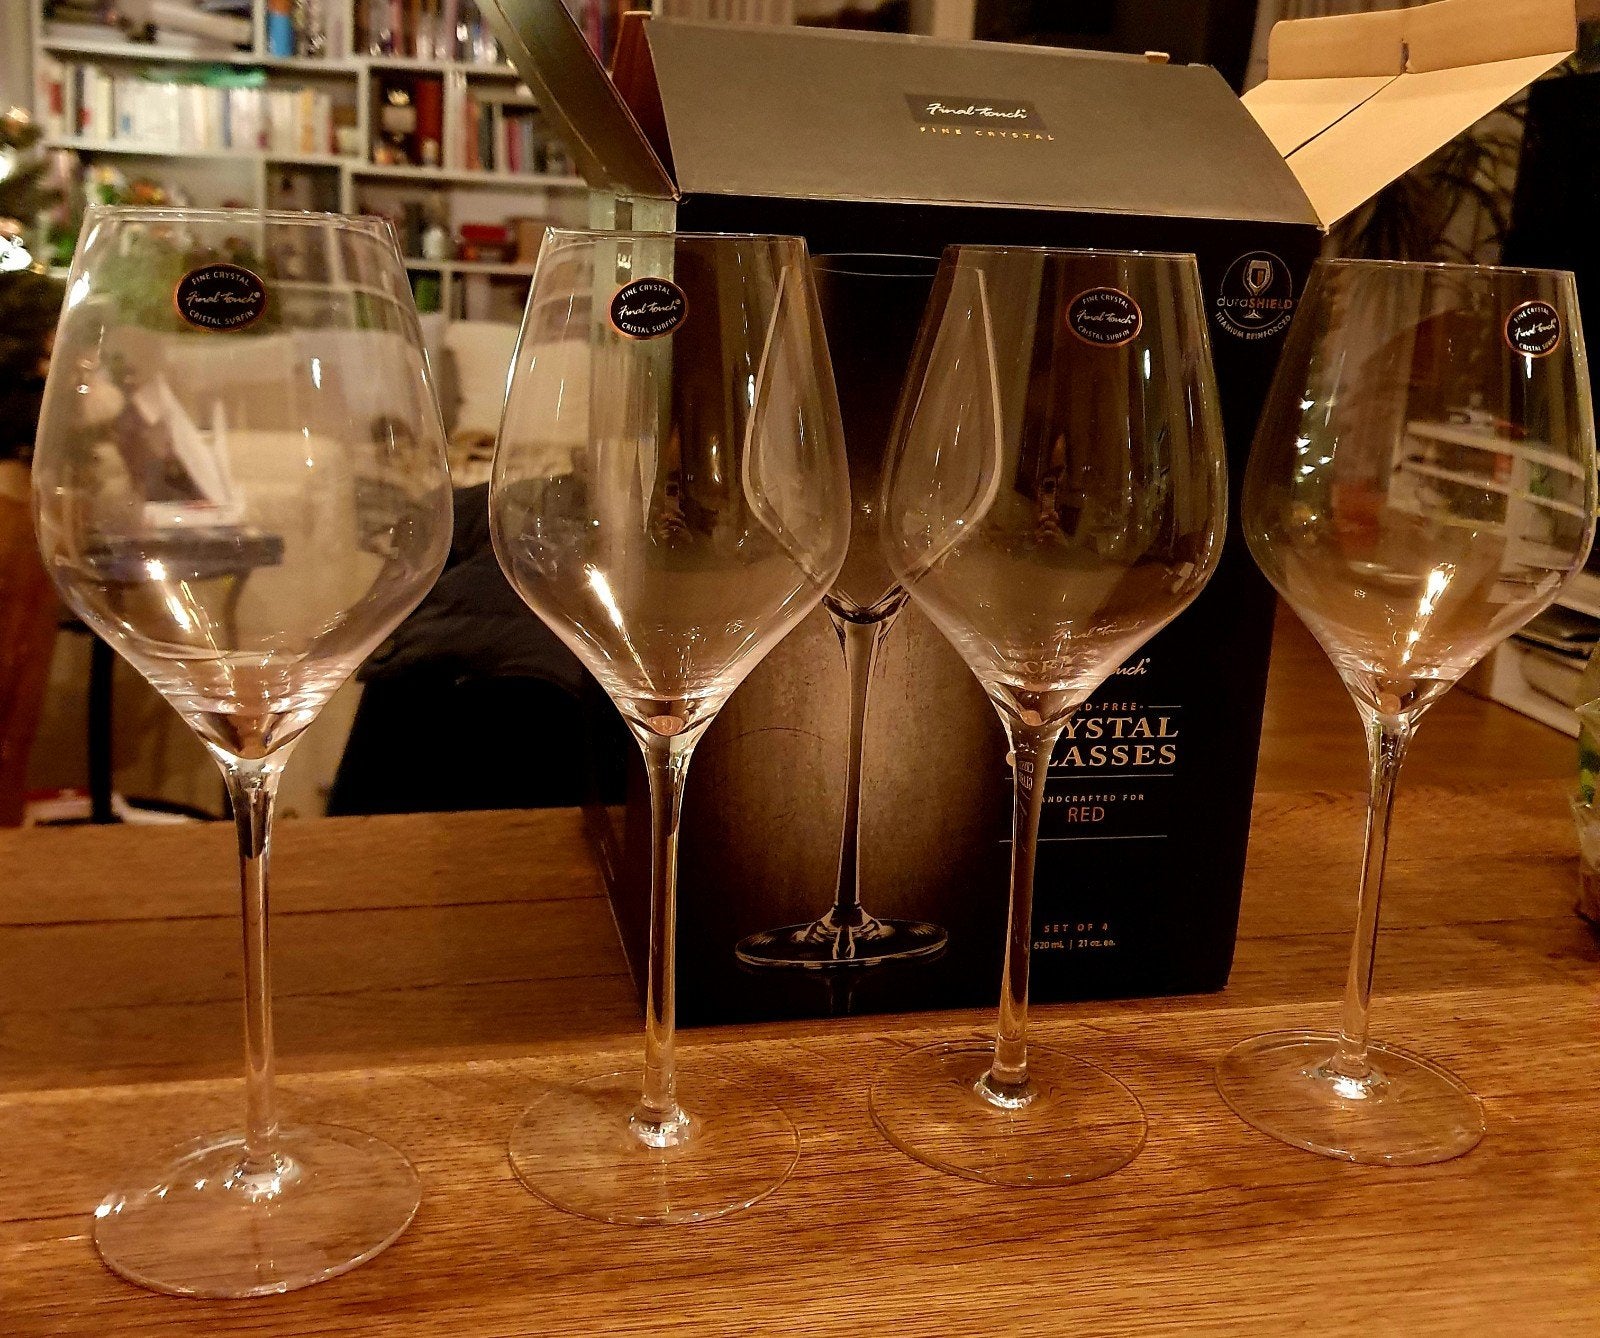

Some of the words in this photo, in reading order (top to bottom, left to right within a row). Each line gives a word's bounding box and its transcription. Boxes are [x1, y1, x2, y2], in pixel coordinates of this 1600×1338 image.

[927, 103, 974, 115] Final
[974, 106, 1027, 119] Touch
[920, 126, 962, 135] FINE
[975, 130, 1055, 141] CRYSTAL
[191, 273, 211, 285] FINE
[213, 271, 250, 286] CRYSTAL
[186, 290, 220, 307] Final
[621, 286, 638, 301] FINE
[639, 284, 670, 296] CRYSTAL
[1082, 294, 1098, 305] FINE
[1100, 293, 1129, 309] CRYSTAL
[189, 309, 221, 325] CRISTAL
[224, 310, 255, 325] SURFIN
[618, 302, 647, 320] Final
[647, 300, 678, 313] Touch
[621, 322, 650, 334] CRISTAL
[652, 316, 677, 333] SURFIN
[1078, 325, 1104, 341] CRISTAL
[1106, 329, 1130, 341] SURFIN
[1112, 657, 1148, 676] uch
[1064, 716, 1179, 740] YSTAL
[1048, 744, 1177, 767] ASSES
[1042, 794, 1116, 803] NDCRAFTED
[1068, 806, 1105, 823] RED
[1044, 924, 1069, 933] SET
[1077, 923, 1093, 932] OF
[1102, 922, 1108, 931] 4
[1078, 939, 1088, 948] 21
